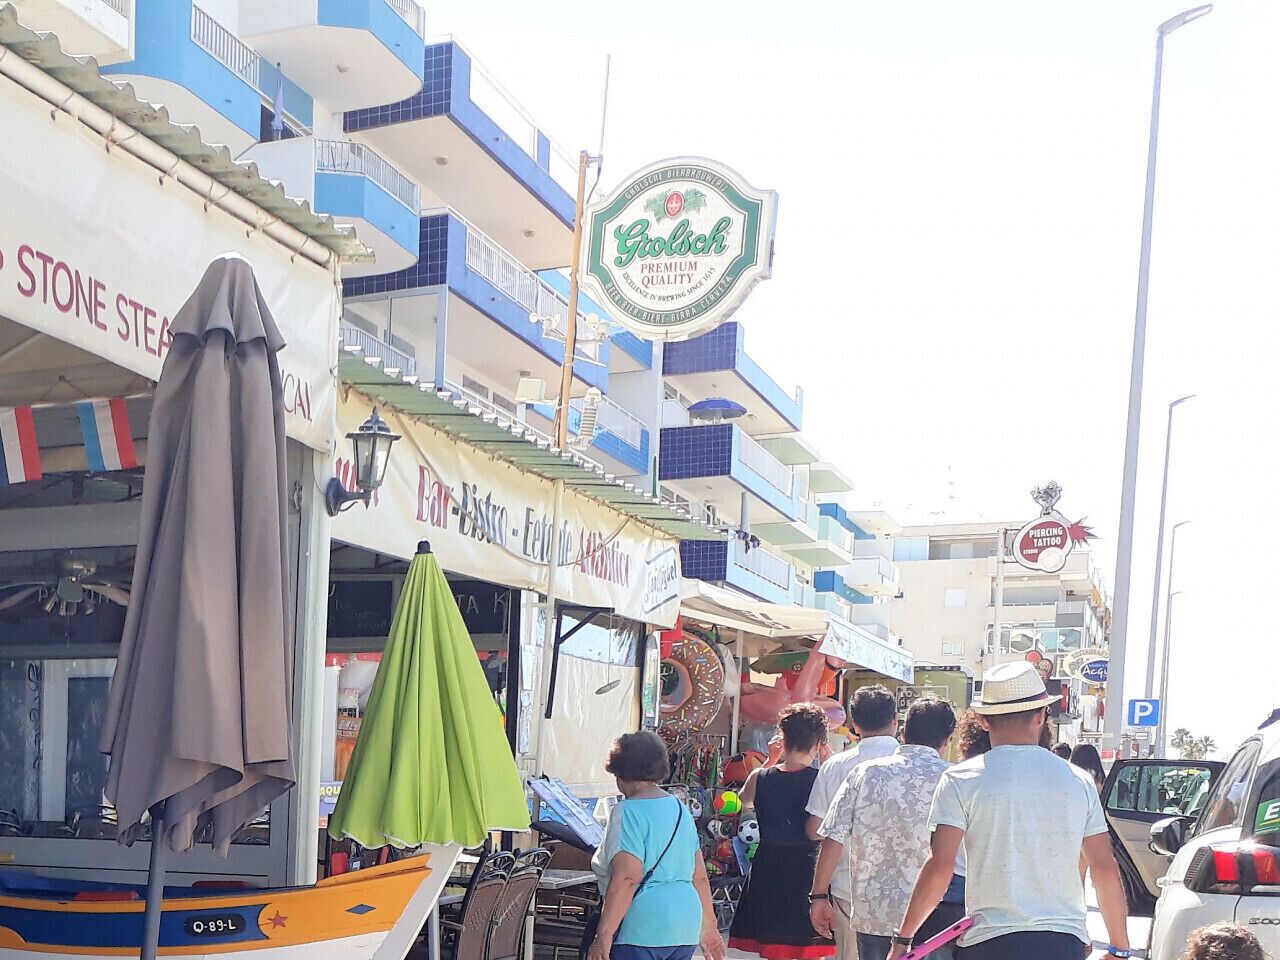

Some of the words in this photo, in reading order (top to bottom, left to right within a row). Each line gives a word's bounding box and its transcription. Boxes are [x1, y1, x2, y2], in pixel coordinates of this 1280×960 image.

[624, 172, 663, 199] GROLSCHE
[666, 168, 729, 192] BIERBROUWERIJ
[614, 216, 733, 268] Grolsch
[640, 261, 698, 274] PREMIUM
[622, 272, 649, 299] EXCELLENCE
[658, 291, 687, 302] BREWING
[687, 281, 704, 295] SINCE
[642, 274, 694, 288] QUALITY
[606, 282, 621, 302] BEER
[621, 301, 639, 317] BIER
[671, 306, 698, 322] BIRRA
[700, 274, 735, 309] CERVEZA
[17, 244, 108, 332] STONE
[116, 293, 175, 358] STEA
[281, 368, 313, 422] CAL
[1028, 527, 1063, 538] PIERCING
[1033, 537, 1061, 547] TATTOO
[1133, 701, 1154, 725] P
[1264, 802, 1280, 821] E
